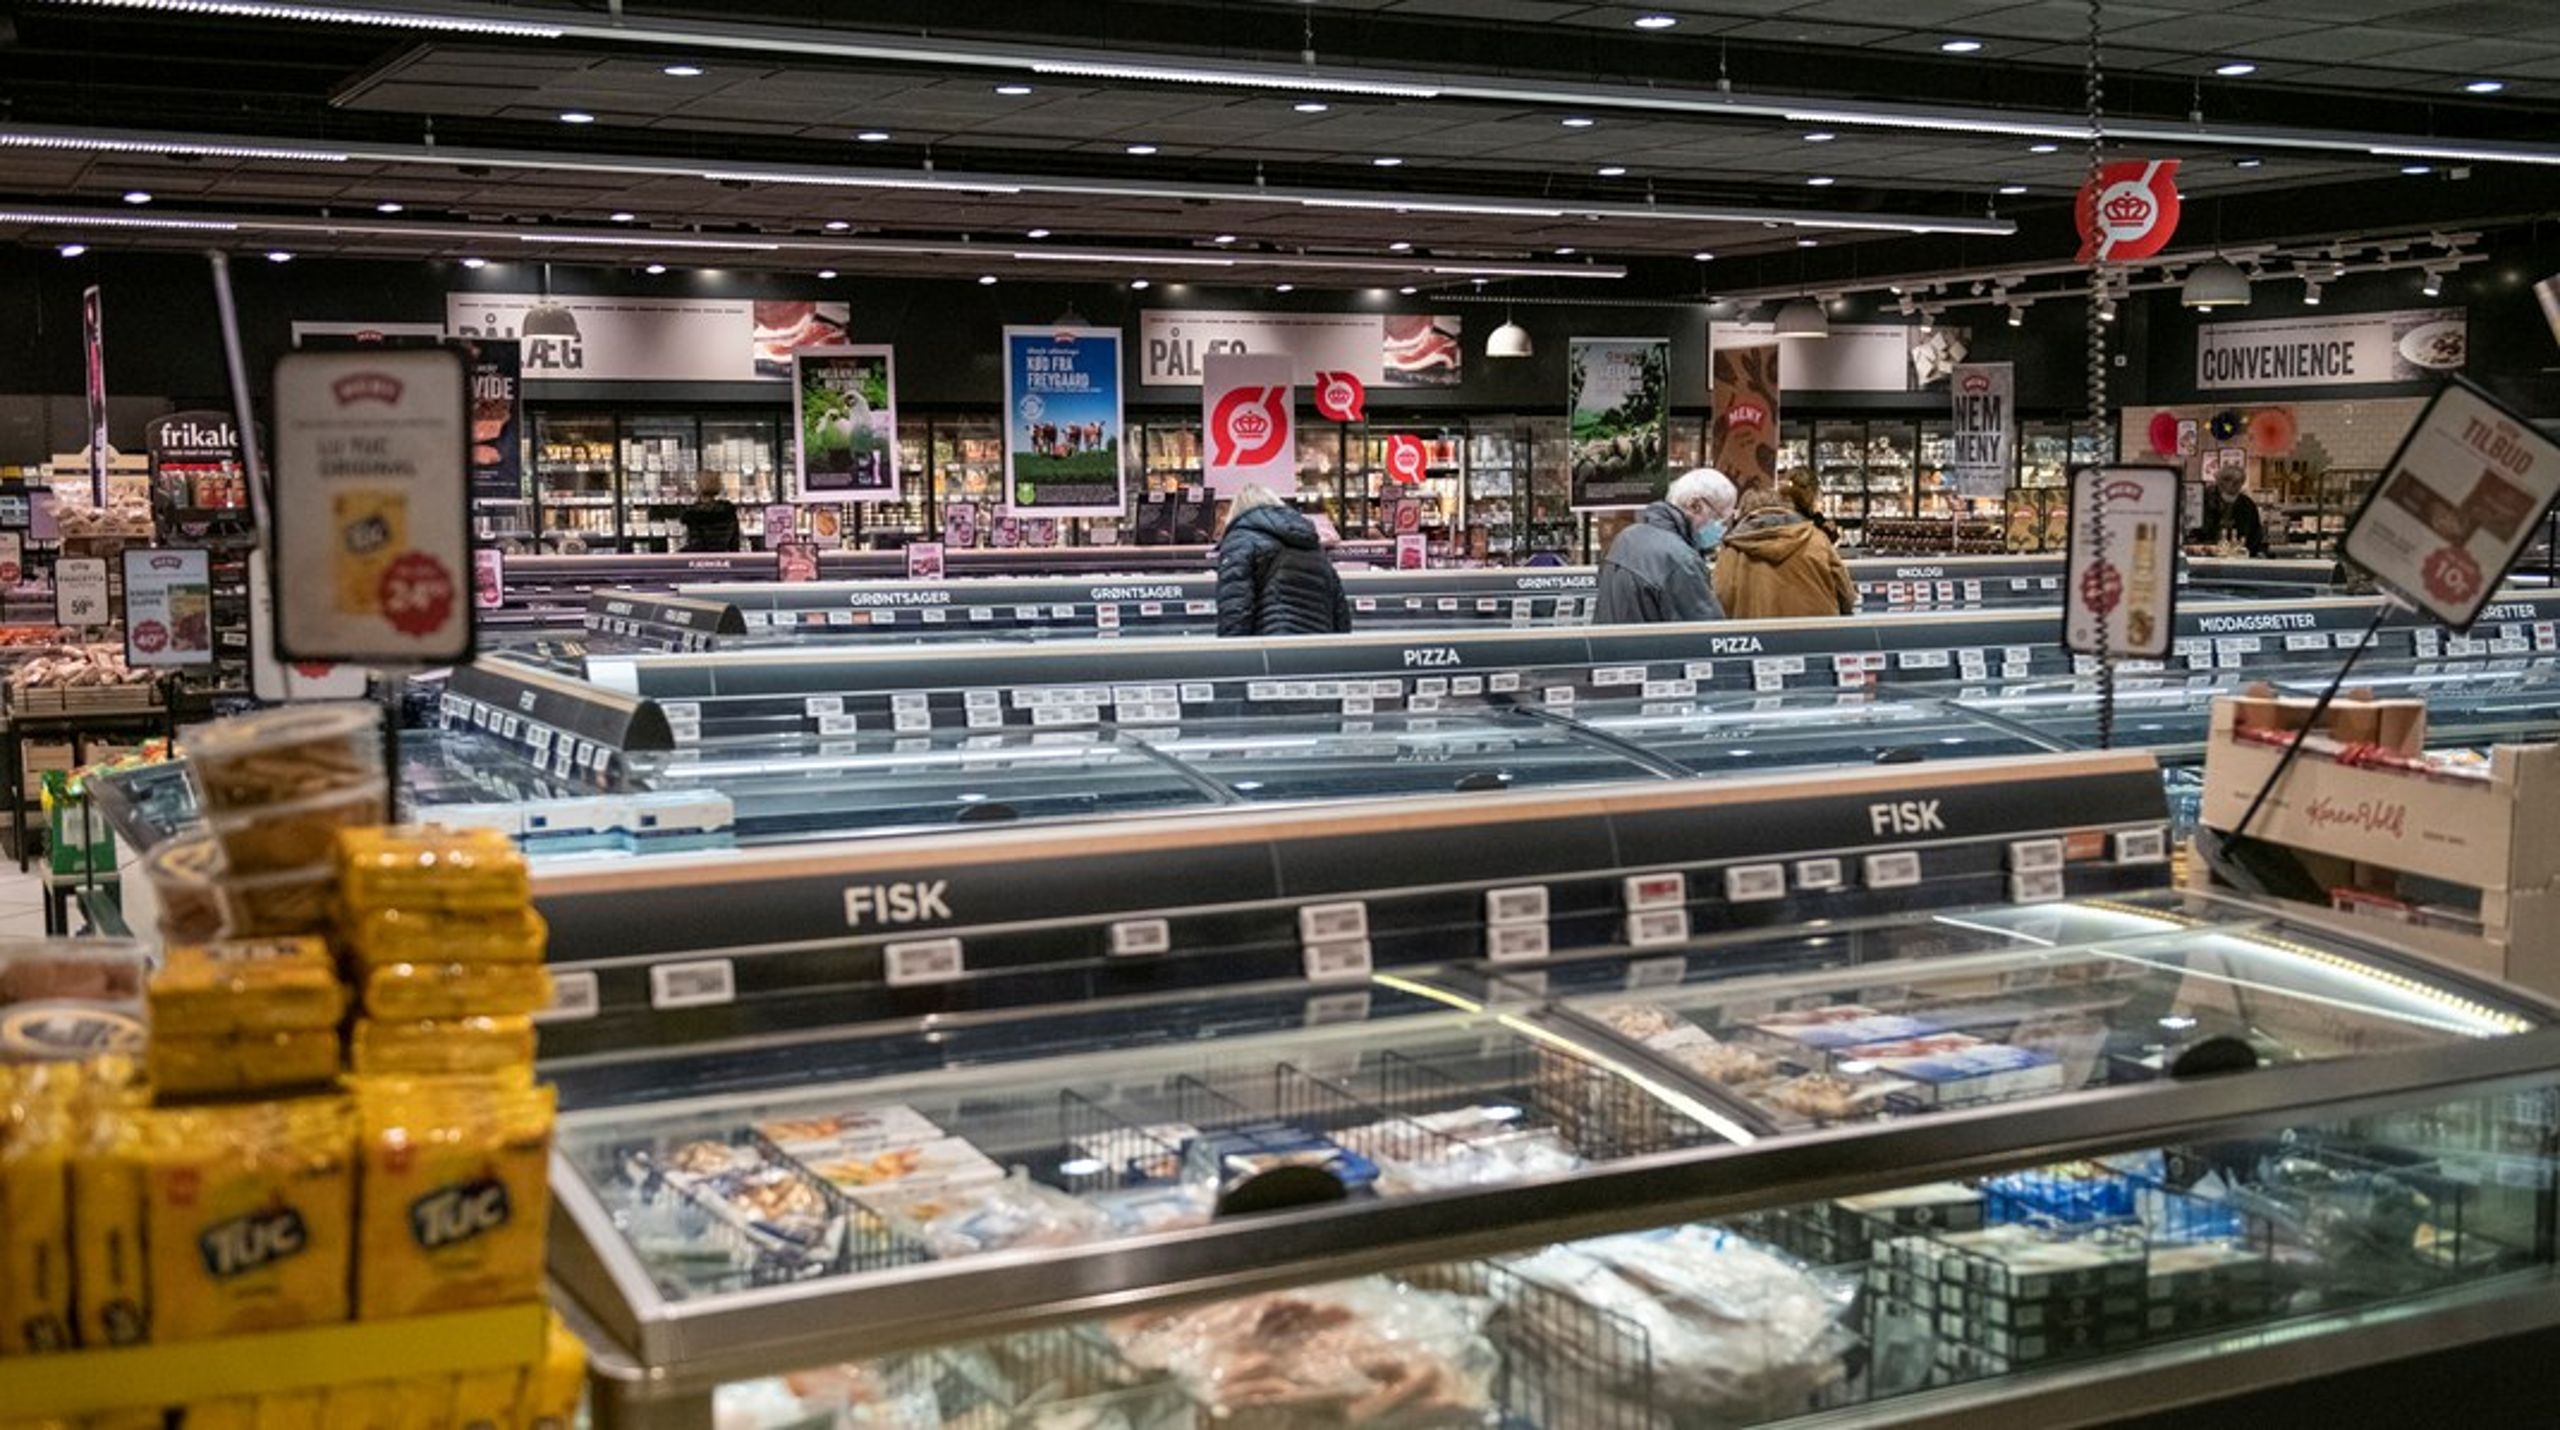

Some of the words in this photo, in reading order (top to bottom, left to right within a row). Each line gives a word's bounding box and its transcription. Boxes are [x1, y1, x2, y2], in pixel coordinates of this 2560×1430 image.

[2203, 341, 2355, 381] CONVENIENCE
[1729, 406, 1762, 426] MENY
[1956, 394, 2001, 431] NEM
[1955, 436, 2001, 462] MENY
[2462, 415, 2534, 476] TILBUD
[1517, 576, 1596, 590] GRØNTSAGER
[1896, 566, 1944, 578] ØKOLOGI
[851, 592, 950, 606] GRØNTSAGER
[1091, 586, 1183, 600] GRØNTSAGER
[2199, 613, 2317, 632] MIDDAGSRETTER
[1712, 636, 1764, 654] PIZZA
[1404, 648, 1461, 666] PIZZA
[1869, 799, 1945, 835] FISK
[844, 880, 952, 926] FISK
[413, 1186, 505, 1246] TUC
[203, 1211, 299, 1274] TUC
